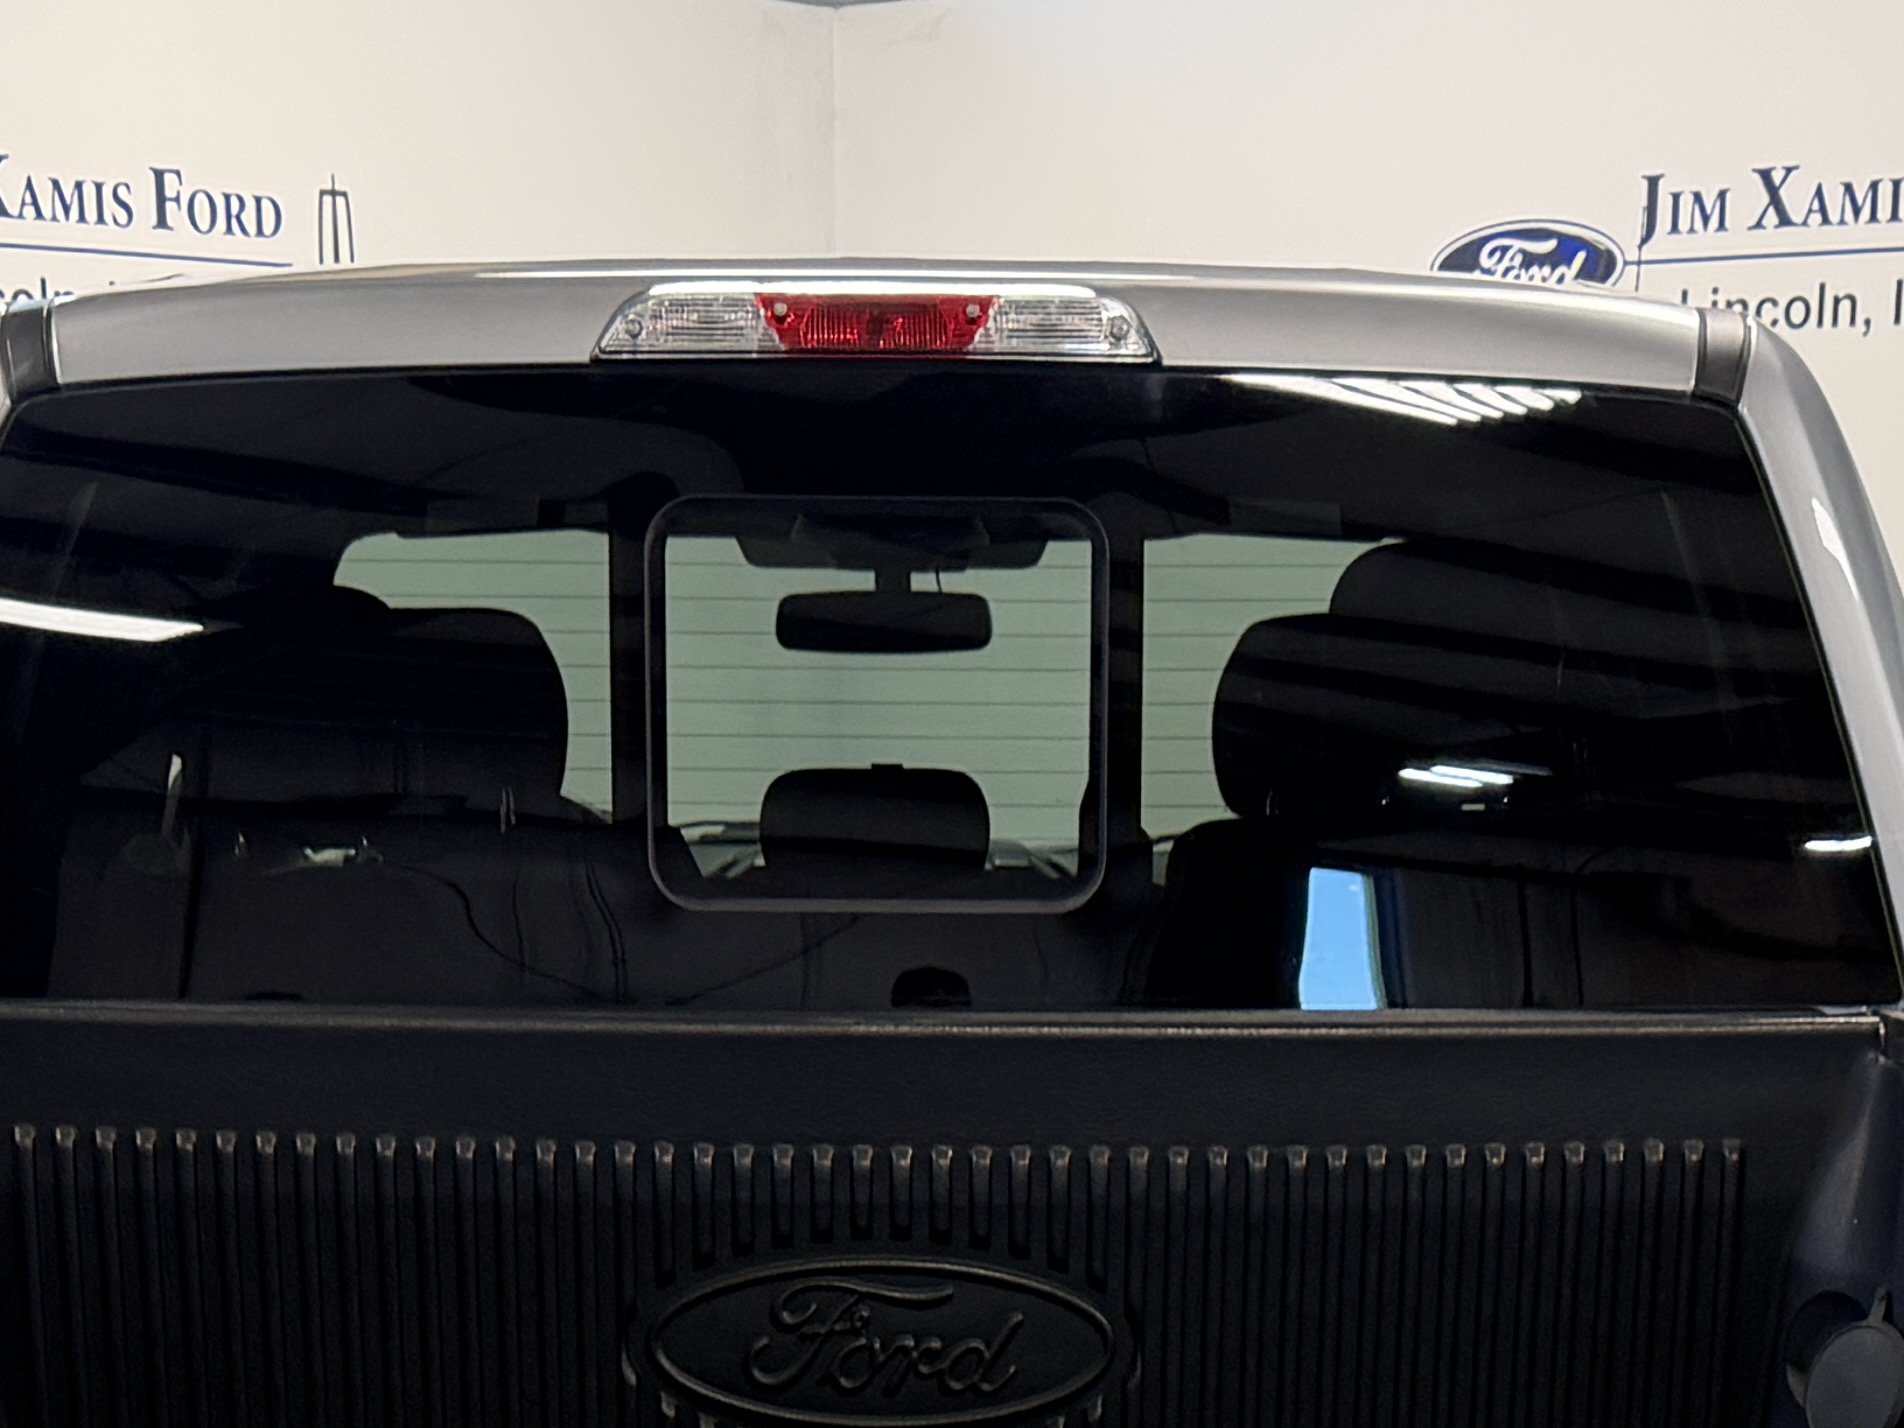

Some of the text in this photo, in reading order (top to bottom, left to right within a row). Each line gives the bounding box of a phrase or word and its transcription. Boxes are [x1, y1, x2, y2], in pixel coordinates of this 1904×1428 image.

[149, 166, 283, 240] FORD
[1638, 172, 1731, 247] JIM
[744, 1274, 1025, 1394] Ford
